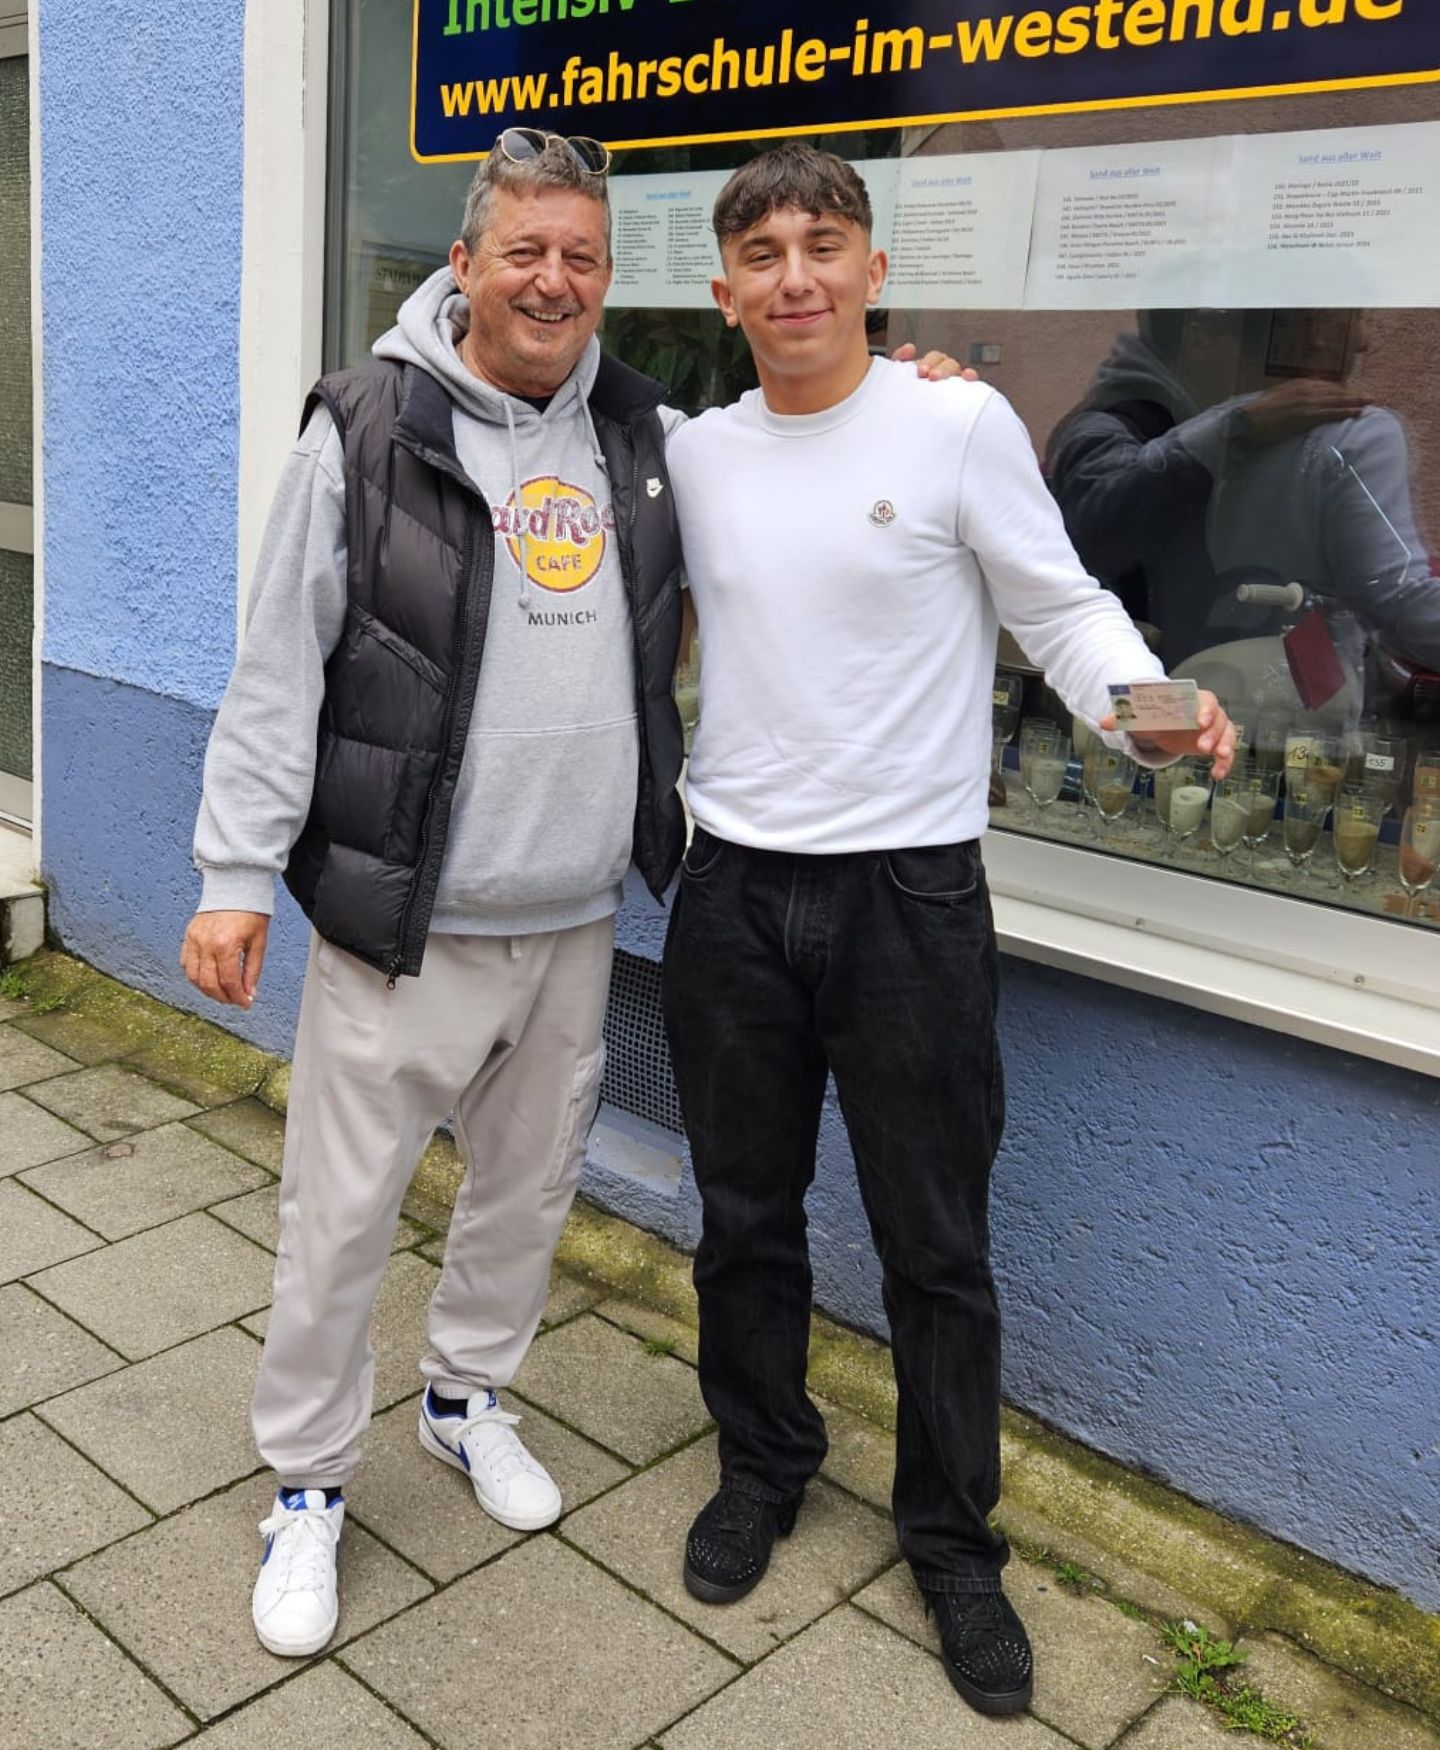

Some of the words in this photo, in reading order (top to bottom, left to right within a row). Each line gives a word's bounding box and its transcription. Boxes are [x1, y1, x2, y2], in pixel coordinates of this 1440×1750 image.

[443, 0, 635, 36] Intens
[492, 498, 552, 538] ard
[554, 498, 616, 545] Roc
[536, 553, 583, 572] CAFE
[528, 611, 597, 626] MUNICH
